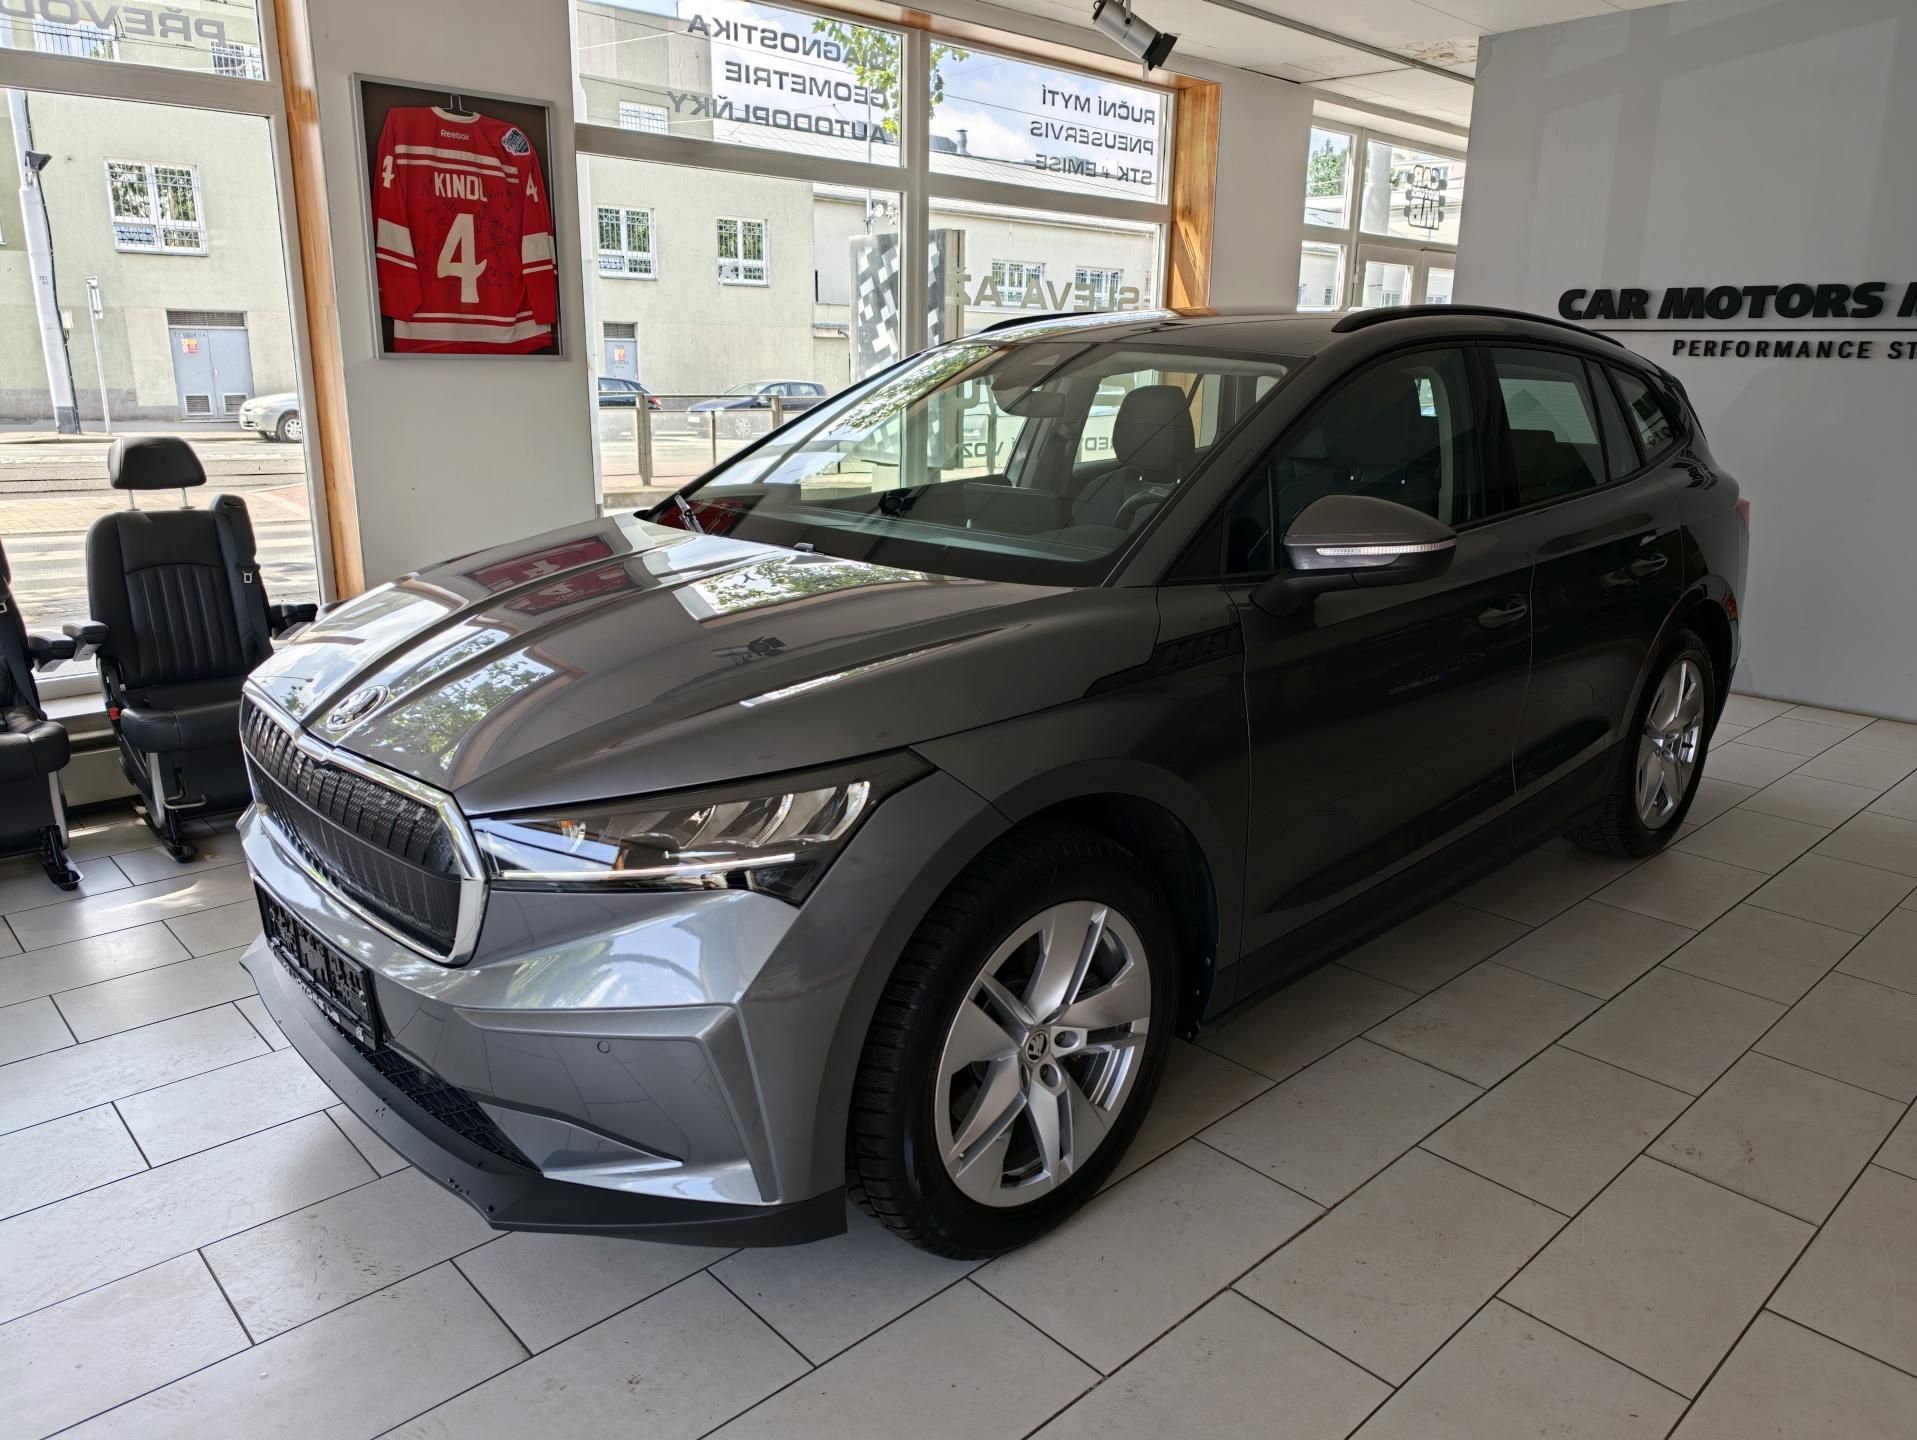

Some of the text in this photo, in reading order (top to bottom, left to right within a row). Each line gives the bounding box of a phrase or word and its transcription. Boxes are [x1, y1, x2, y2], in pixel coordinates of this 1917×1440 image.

[440, 129, 470, 141] Reebok
[382, 155, 395, 189] 4
[434, 171, 488, 202] KINDL
[526, 172, 539, 203] 4
[437, 213, 488, 303] 4
[1558, 288, 1650, 320] CAR
[1658, 282, 1886, 320] MOTORS
[1672, 339, 1873, 359] PERFORMANCE
